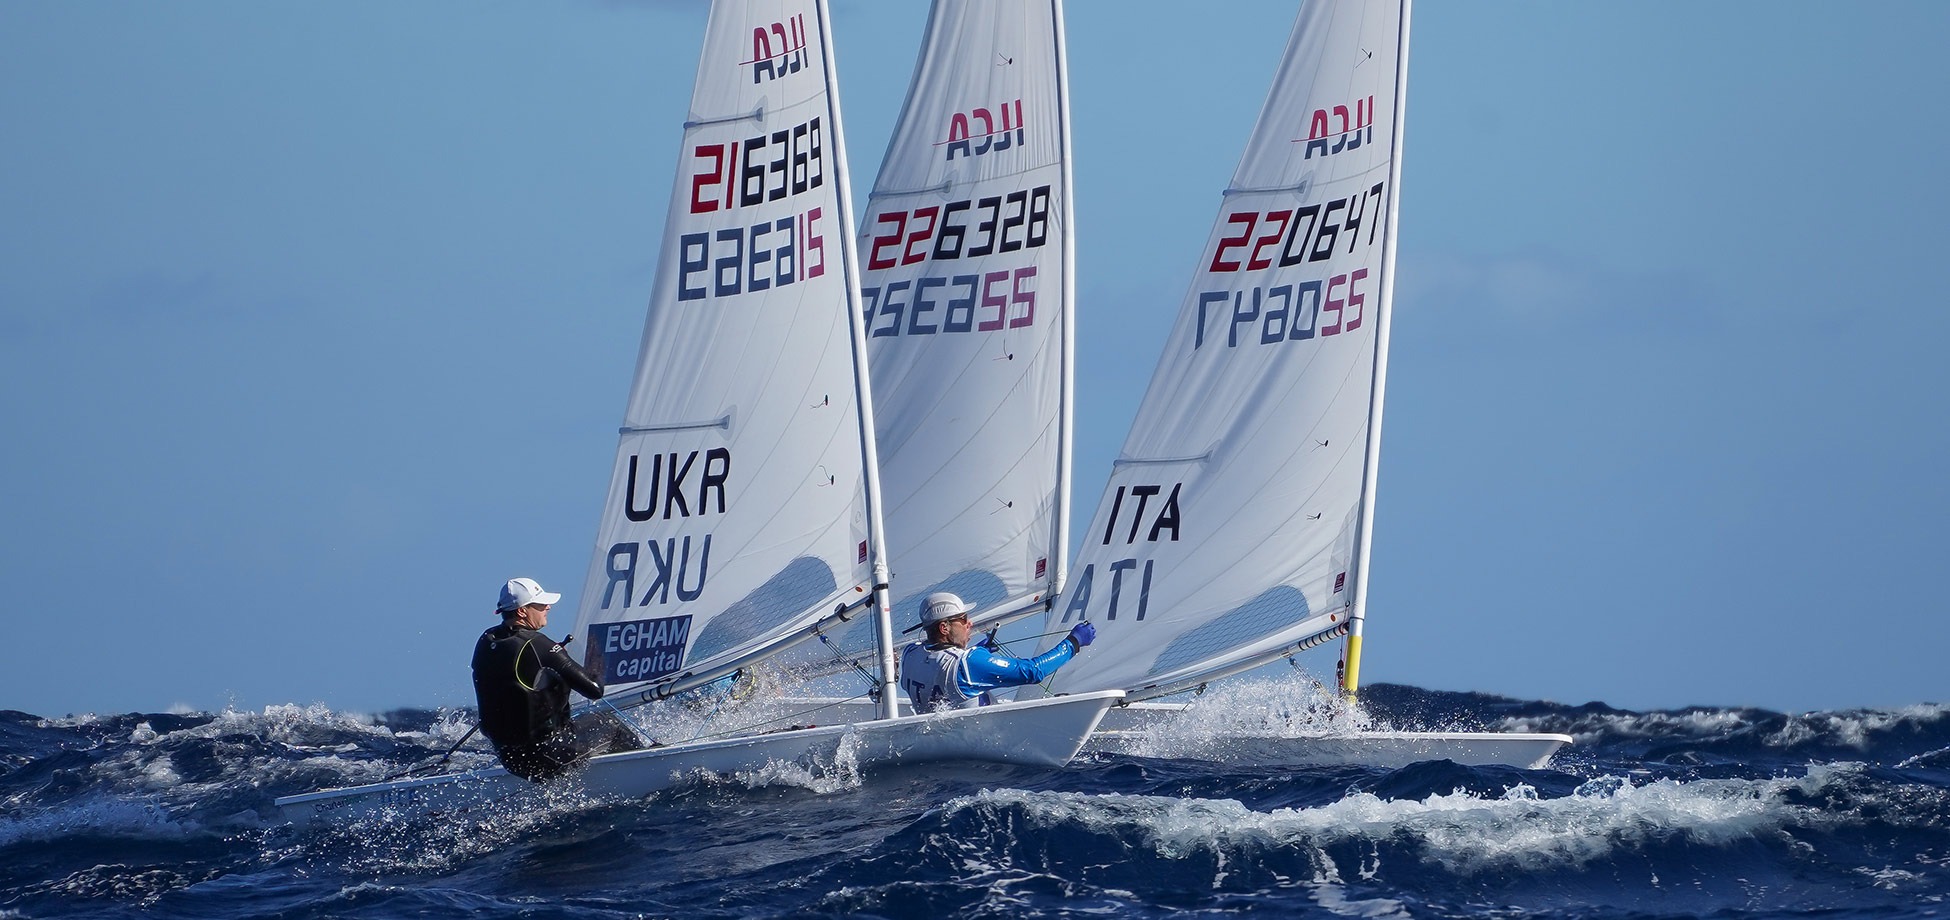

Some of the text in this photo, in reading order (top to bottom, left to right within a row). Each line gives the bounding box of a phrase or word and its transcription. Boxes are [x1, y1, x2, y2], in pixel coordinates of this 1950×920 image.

[690, 116, 822, 214] 216369
[867, 185, 1050, 270] 226328
[1209, 181, 1384, 272] 220647
[625, 447, 730, 521] UKR
[1102, 482, 1182, 545] ITA
[605, 618, 691, 652] EGHAM
[617, 648, 684, 679] capital
[907, 678, 951, 703] ITA
